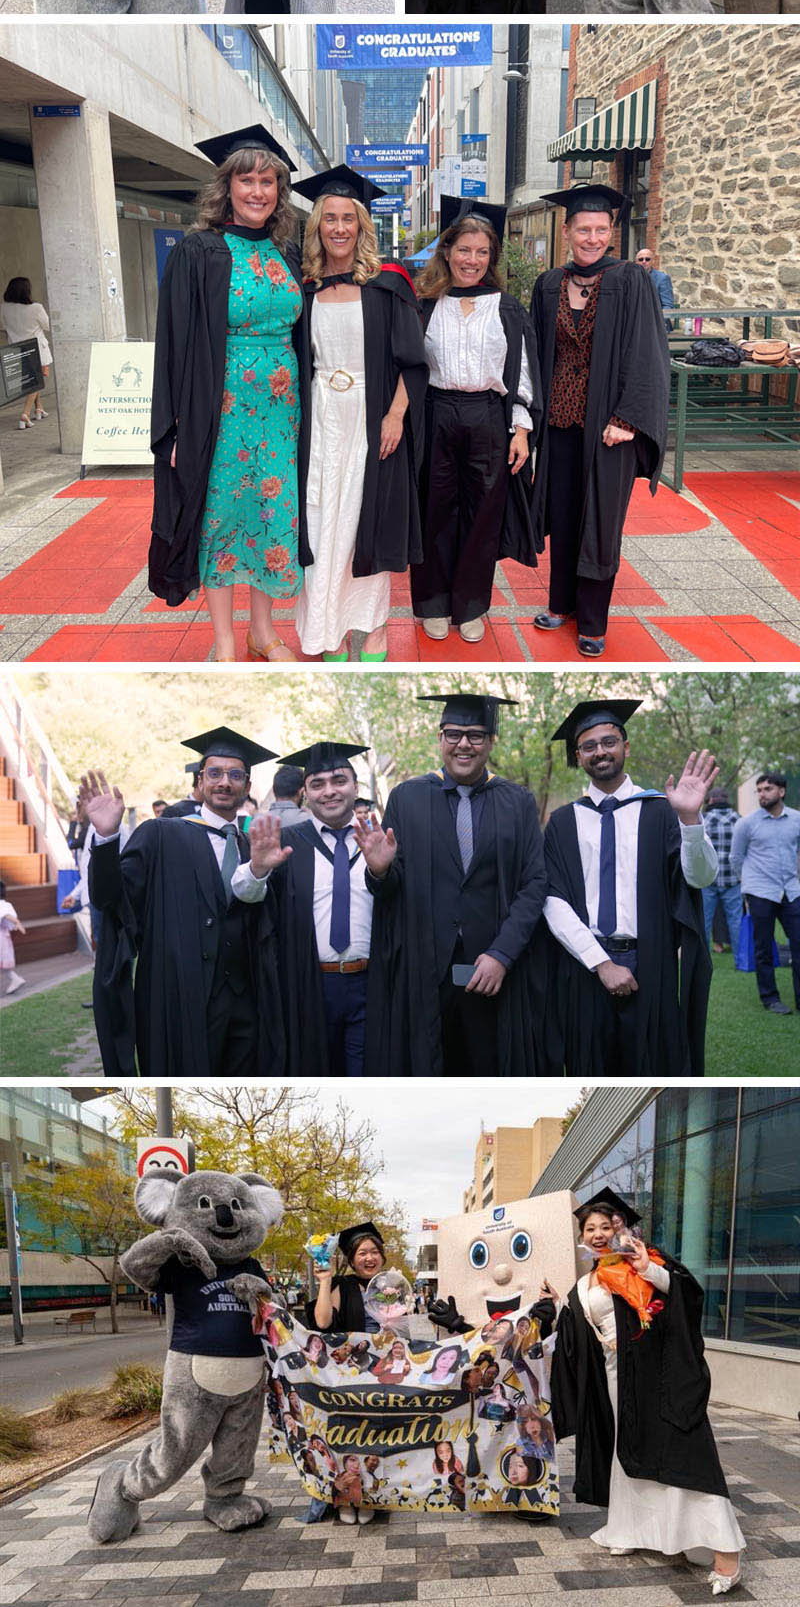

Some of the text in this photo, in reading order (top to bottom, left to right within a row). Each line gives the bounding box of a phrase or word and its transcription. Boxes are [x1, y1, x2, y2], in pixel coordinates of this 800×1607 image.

[356, 31, 481, 46] CONGRATULATIONS
[380, 45, 457, 58] GRADUATES
[96, 426, 151, 438] Coffee Her
[217, 1293, 236, 1302] SOU
[318, 1391, 455, 1408] CONGRATS
